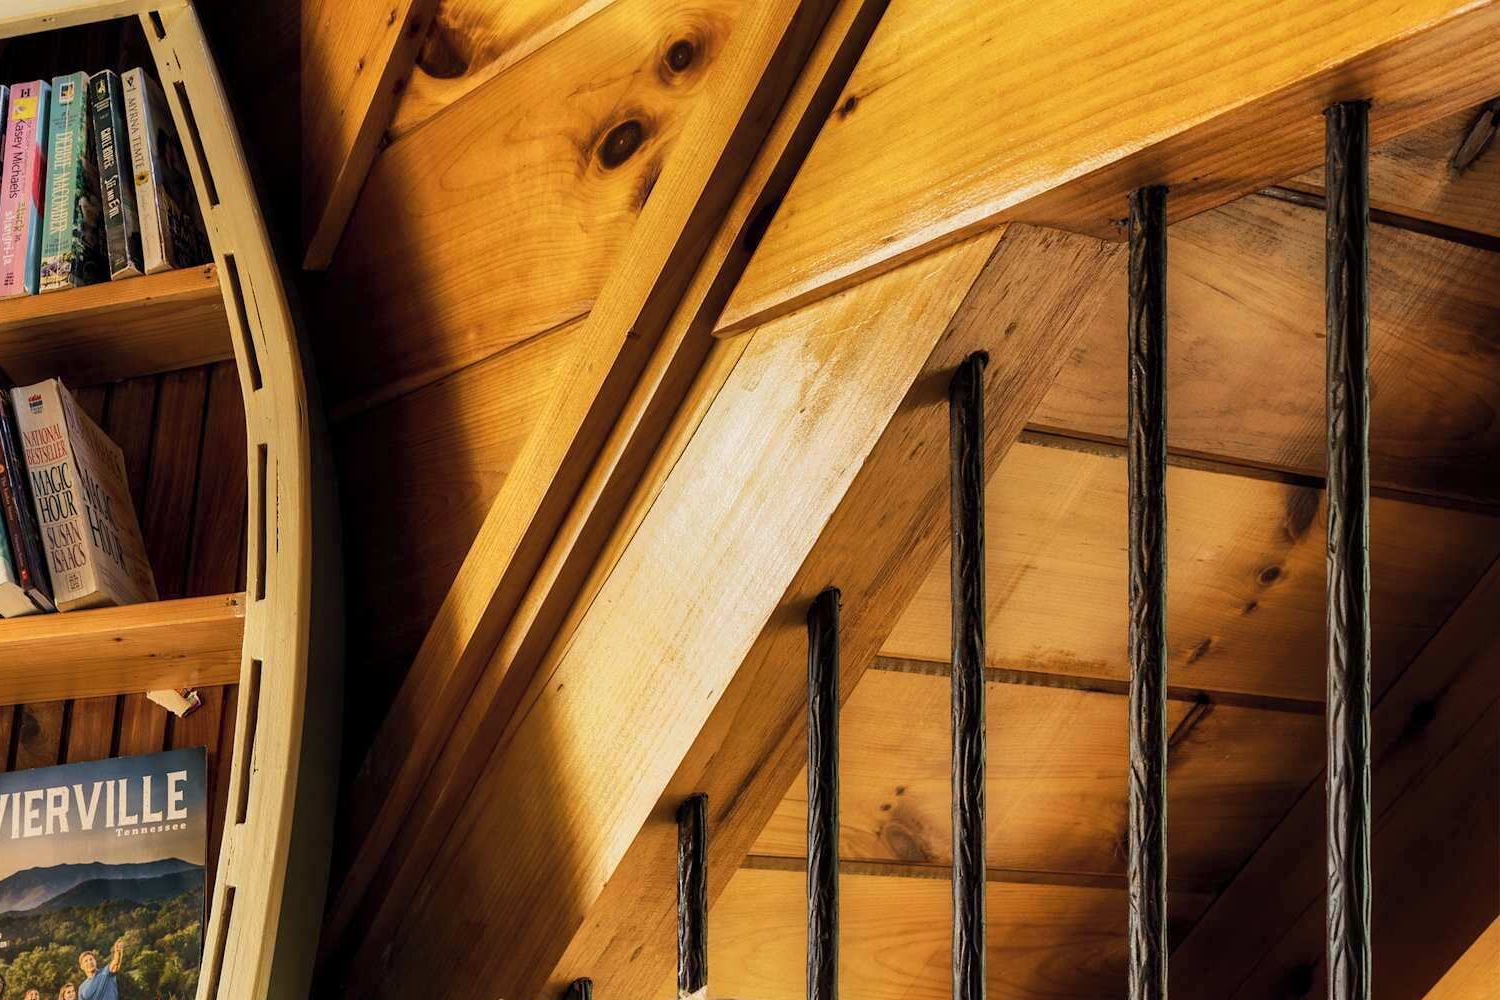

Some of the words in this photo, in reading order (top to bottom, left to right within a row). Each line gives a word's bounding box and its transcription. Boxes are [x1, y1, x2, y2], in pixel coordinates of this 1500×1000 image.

[127, 96, 141, 133] MYRNA
[14, 119, 27, 149] Kasey
[54, 131, 72, 170] DEBBIE
[131, 134, 143, 169] TEMTE
[9, 152, 23, 199] Michaels
[51, 172, 72, 234] MACOMBER
[3, 209, 14, 265] shangri-la
[23, 424, 62, 447] NATIONAL
[27, 439, 67, 465] BESTSELLER
[31, 462, 72, 496] MAGIC
[38, 490, 77, 523] HOUR
[46, 520, 82, 549] SUSAN
[51, 542, 86, 574] ISAACS
[116, 822, 187, 838] Tennessee
